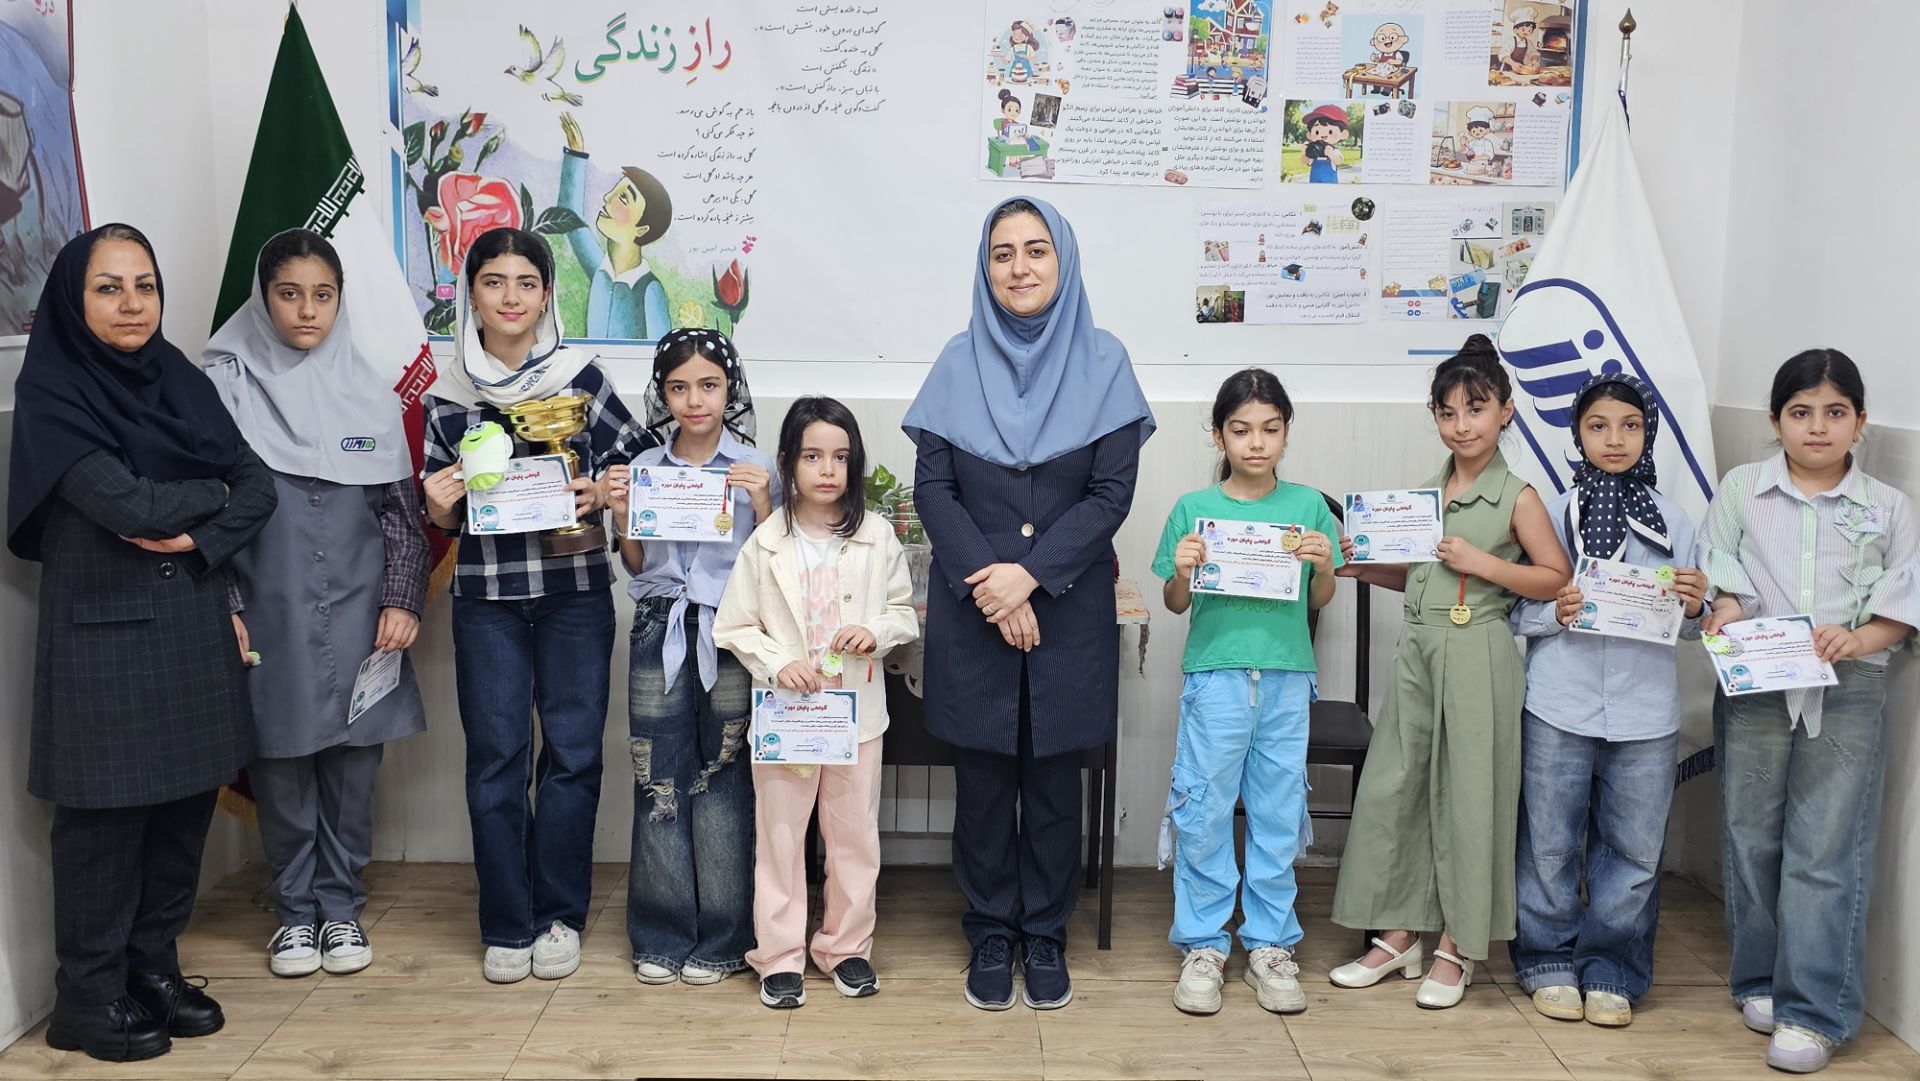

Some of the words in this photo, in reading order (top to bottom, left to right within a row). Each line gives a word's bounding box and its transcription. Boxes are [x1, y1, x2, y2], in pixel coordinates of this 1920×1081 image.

[787, 20, 813, 34] نشستن
[575, 12, 677, 82] زندگی
[868, 42, 883, 57] گل
[824, 58, 848, 75] شکفتن
[808, 77, 832, 94] گفتن
[826, 84, 837, 92] راز
[856, 85, 873, 95] زبان
[706, 102, 731, 119] گوش
[783, 104, 803, 114] درون
[812, 100, 827, 114] گل
[1062, 104, 1074, 112] الگو
[735, 108, 744, 120] هم
[746, 108, 754, 119] باز
[725, 124, 739, 139] فکر
[678, 145, 696, 160] کرده
[690, 150, 707, 159] اشاره
[709, 146, 725, 162] زندگی
[726, 151, 735, 160] راز
[744, 148, 757, 163] گل
[683, 172, 702, 180] است
[704, 168, 717, 183] گل
[722, 172, 735, 183] باشد
[730, 188, 743, 205] یکی
[697, 208, 715, 223] کرده
[710, 214, 721, 224] پاره
[739, 213, 754, 225] بیشتر
[673, 482, 686, 490] پایان
[1240, 538, 1253, 546] پایان
[797, 704, 810, 712] پایان
